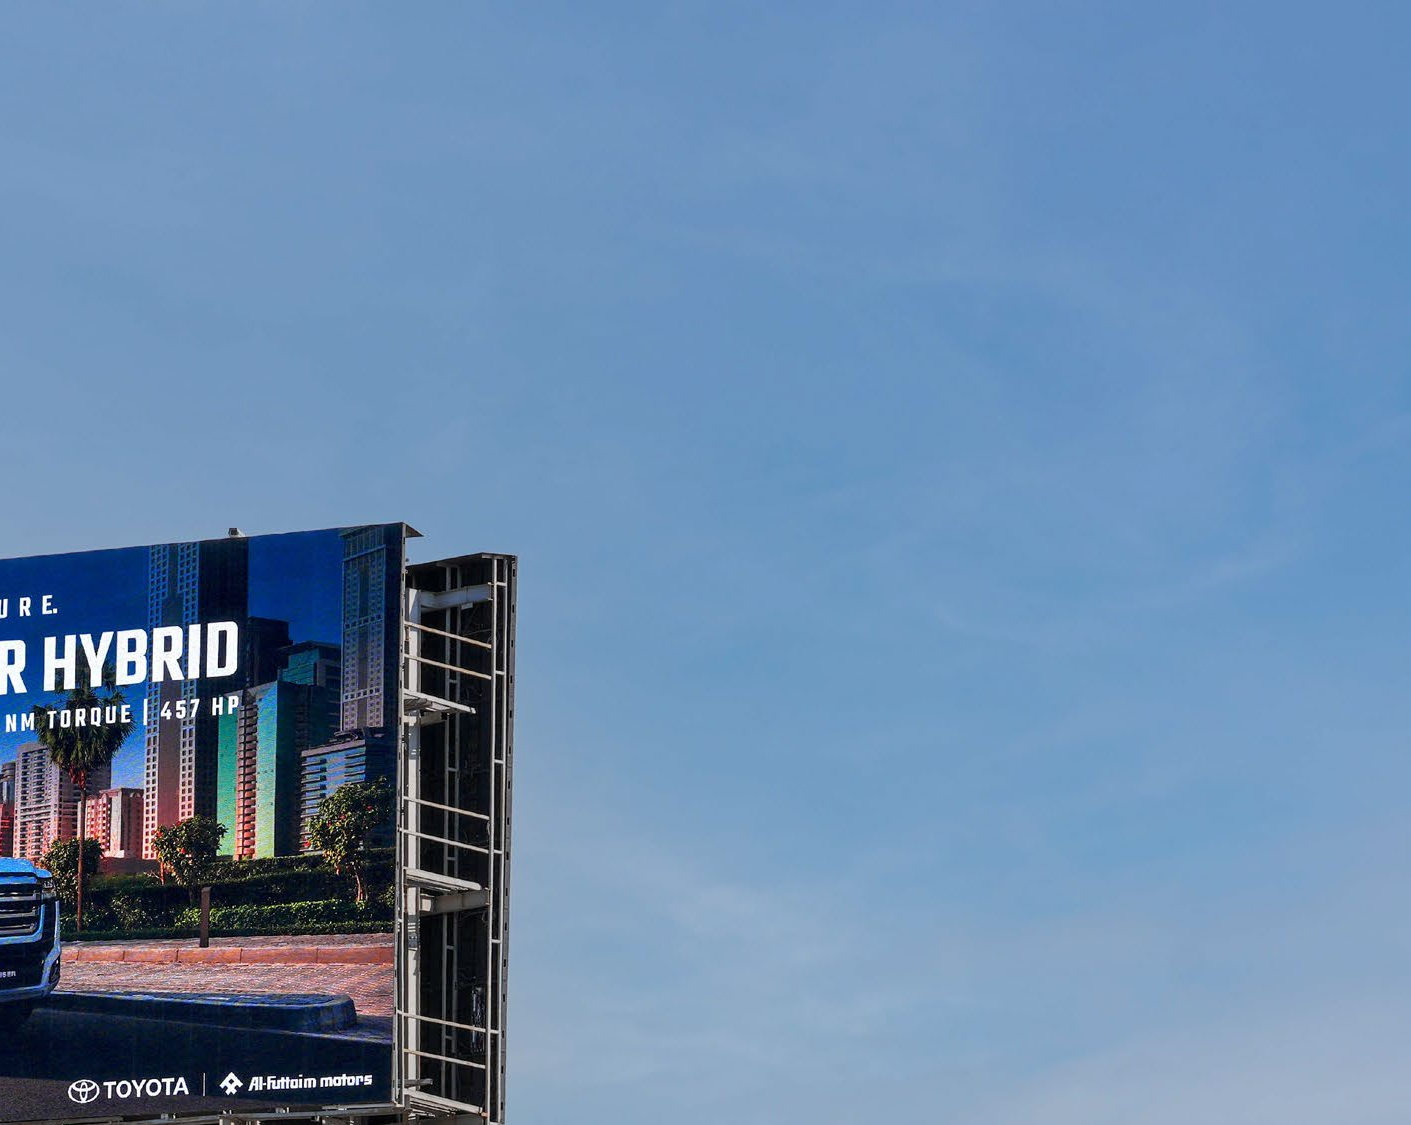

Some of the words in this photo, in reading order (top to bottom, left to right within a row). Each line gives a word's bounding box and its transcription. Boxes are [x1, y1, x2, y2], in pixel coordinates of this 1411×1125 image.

[43, 620, 239, 692] HYBRID
[5, 712, 35, 732] NM
[47, 704, 131, 729] TORQUE
[160, 698, 201, 720] 457
[211, 695, 240, 716] HP
[103, 1077, 190, 1099] TOYOTA
[320, 1073, 373, 1088] motors
